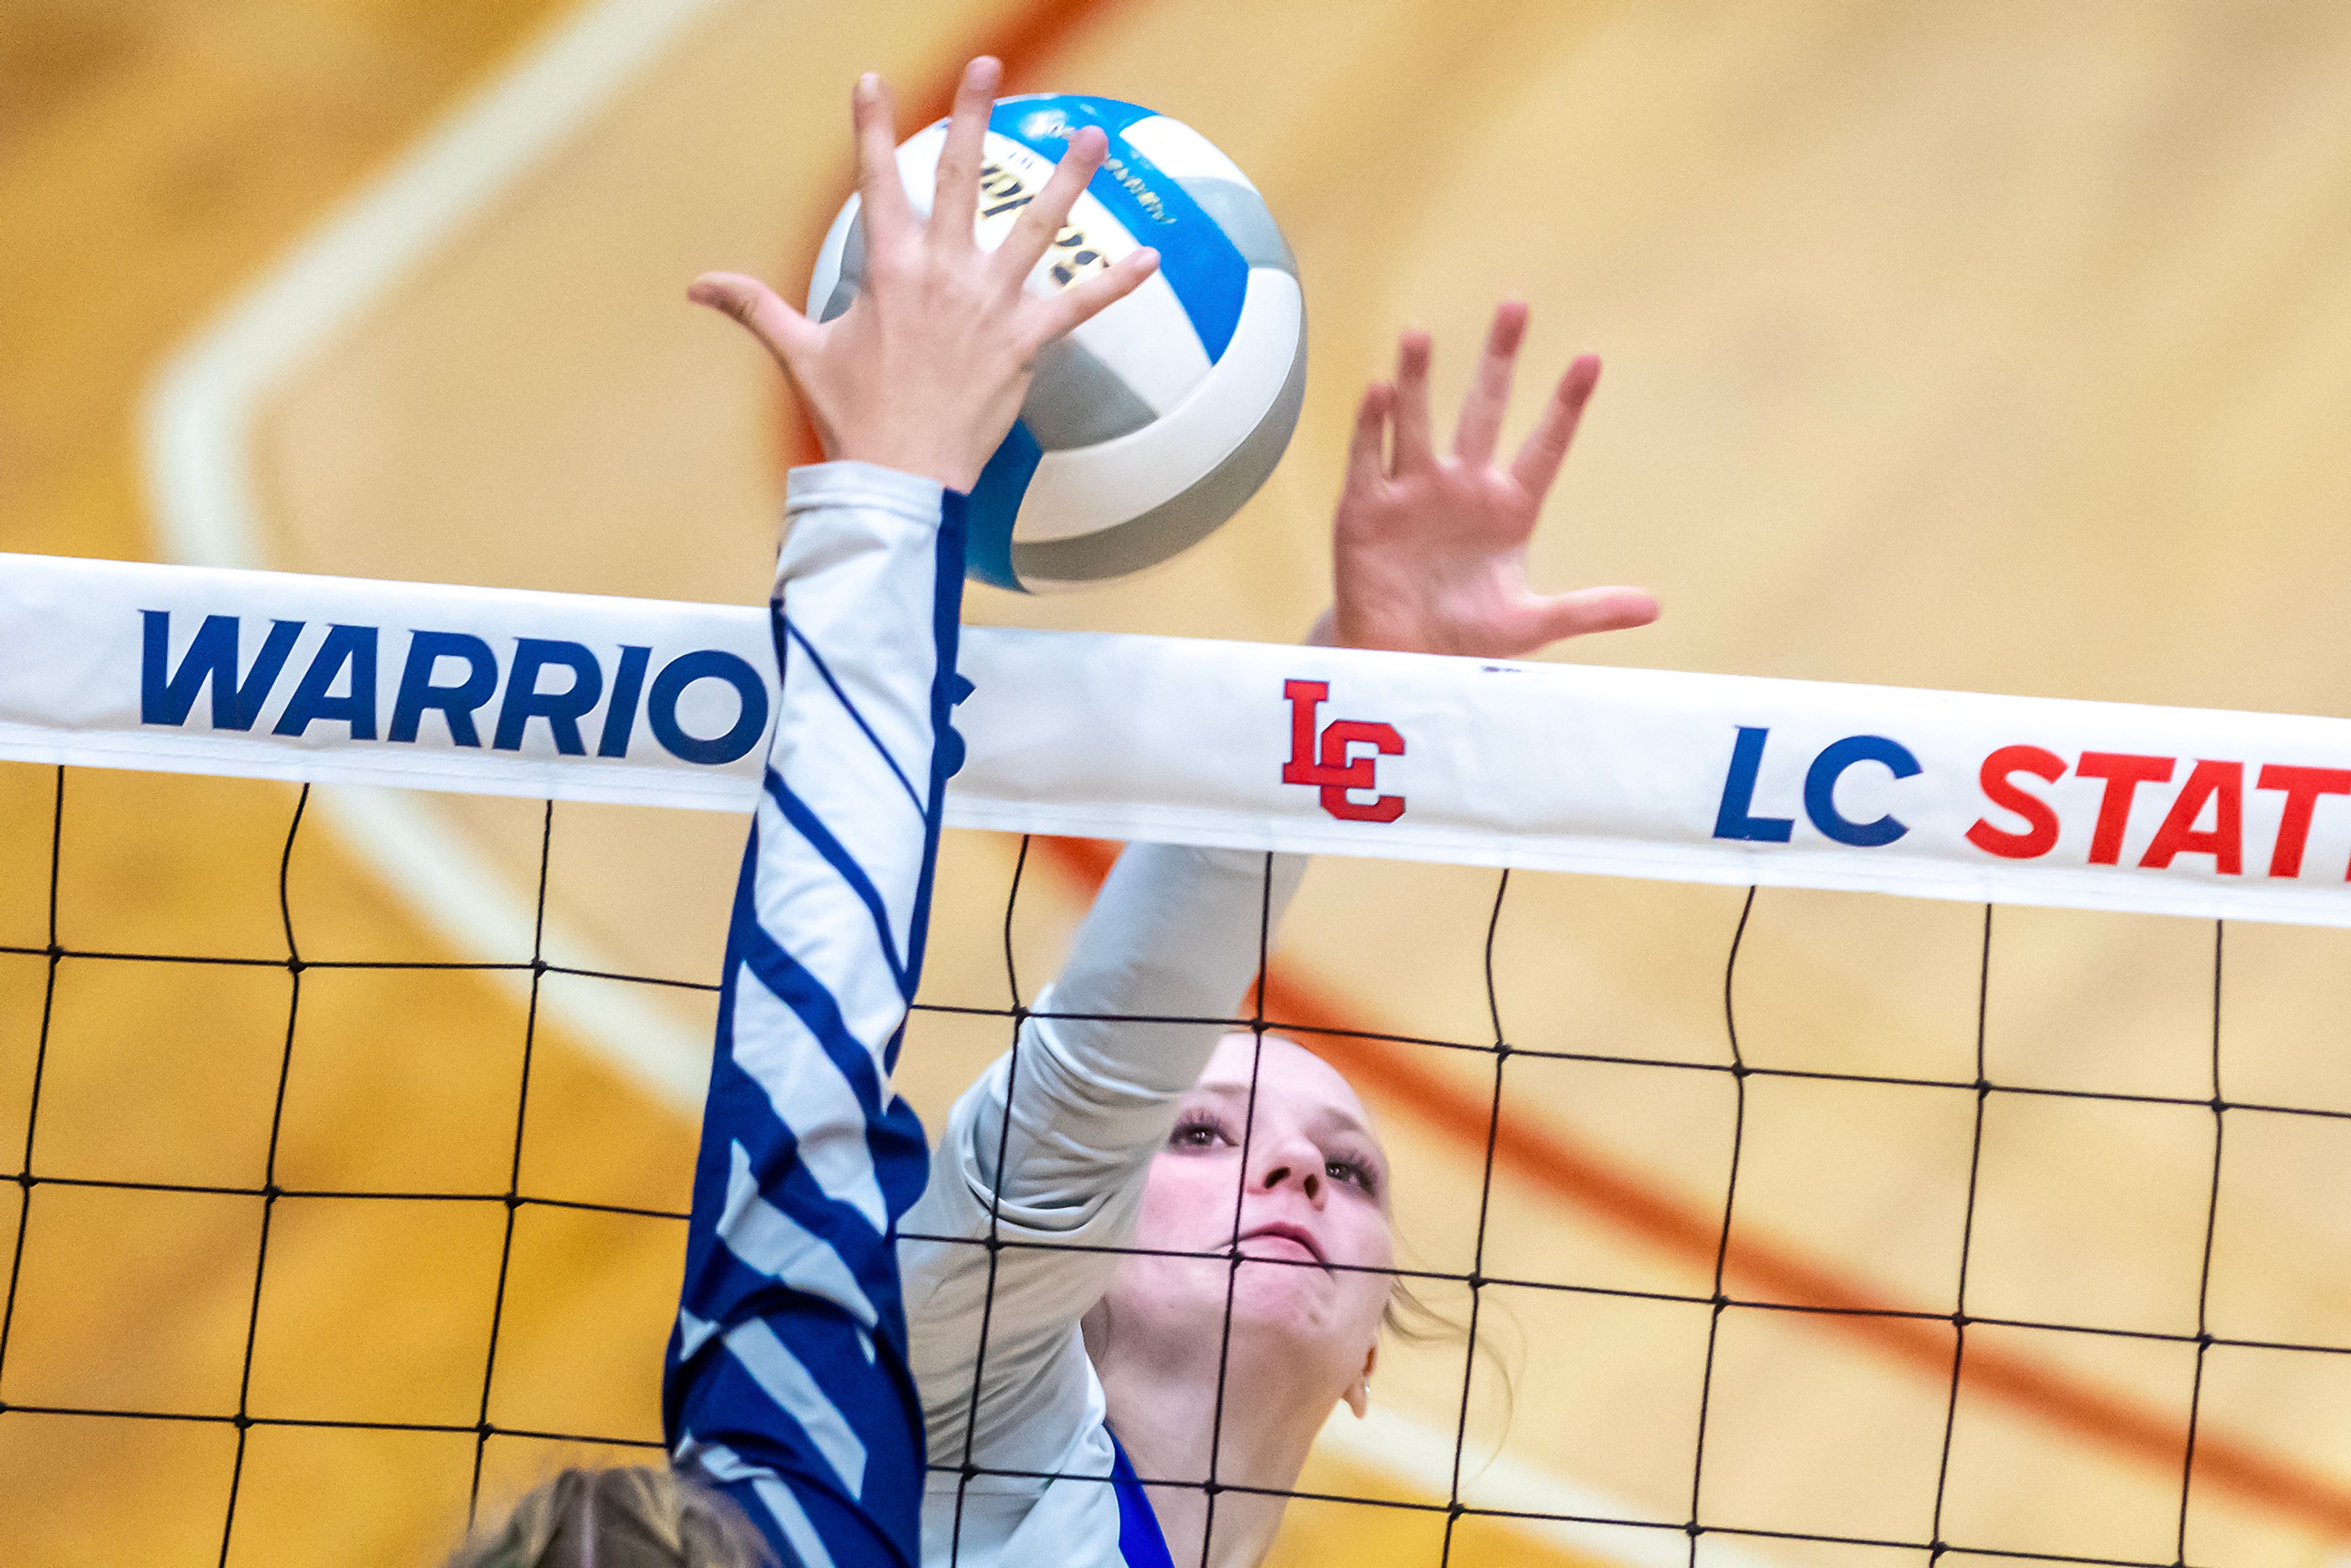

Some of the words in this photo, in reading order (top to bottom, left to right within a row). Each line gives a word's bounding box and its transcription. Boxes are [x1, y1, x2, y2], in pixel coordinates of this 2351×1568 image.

[138, 609, 976, 781] WARRIO
[1283, 678, 1406, 823] LC
[1712, 725, 1923, 847] LC
[1964, 744, 2351, 882] STAT
